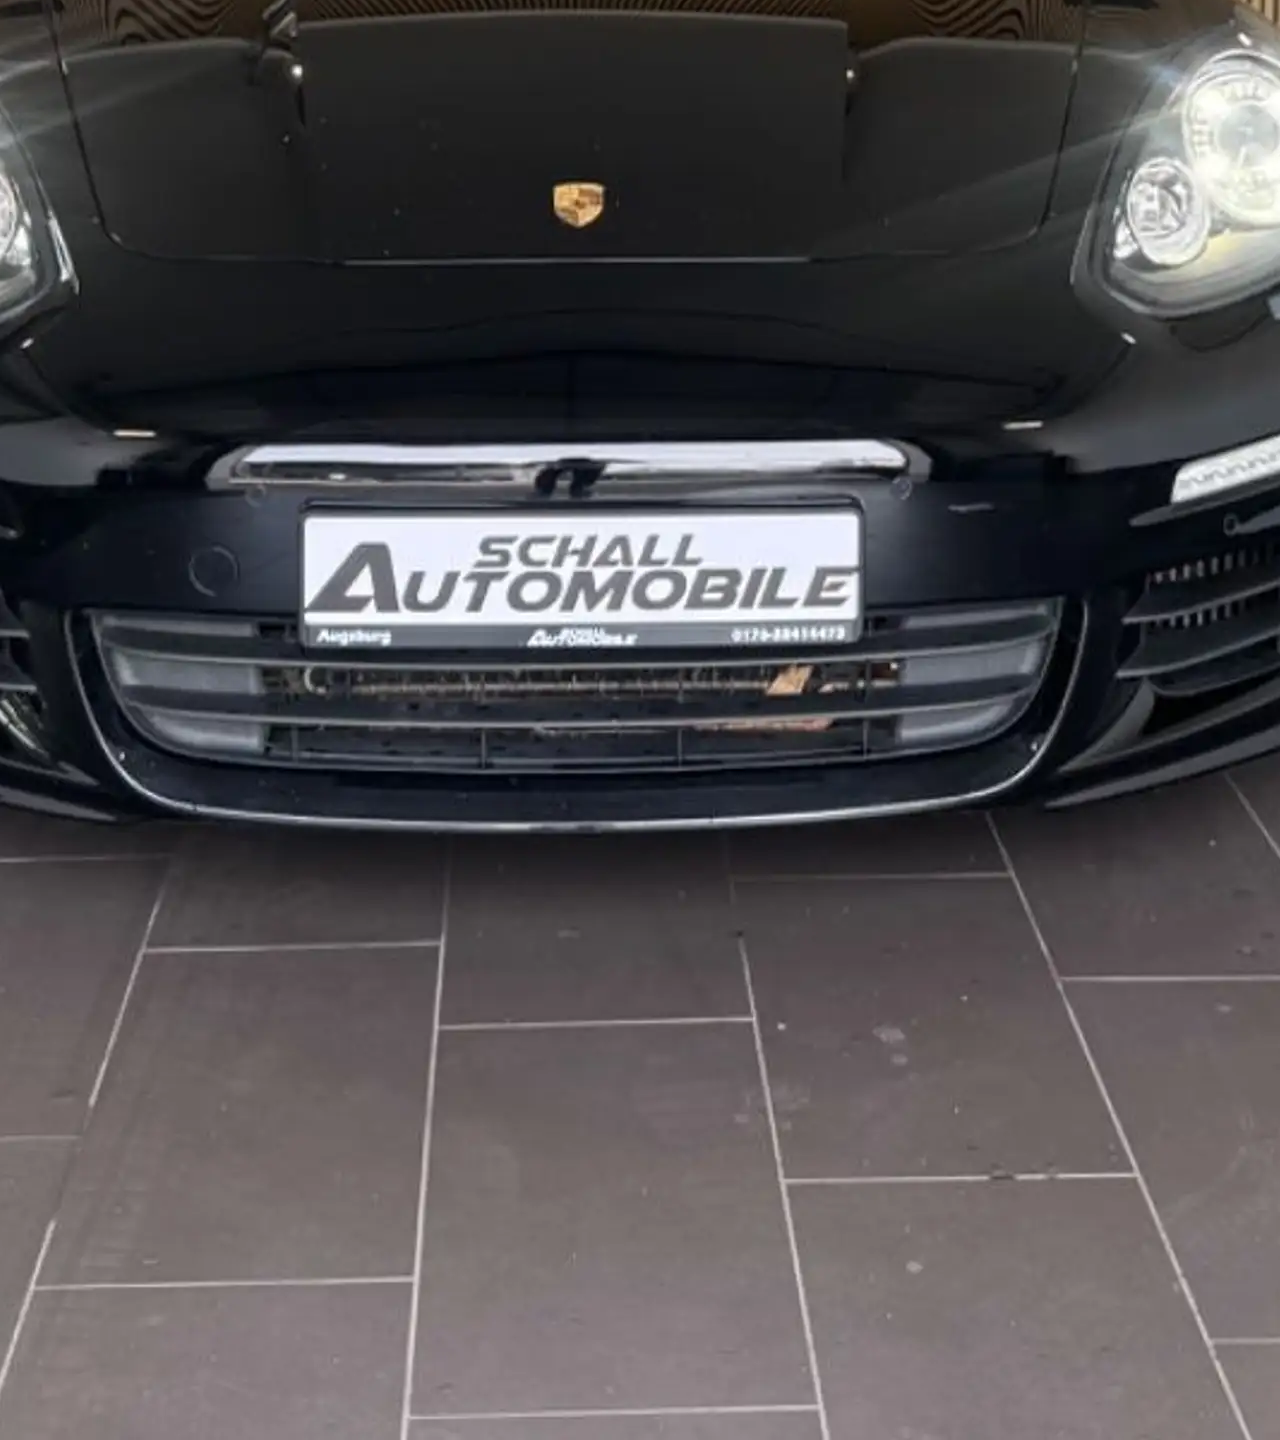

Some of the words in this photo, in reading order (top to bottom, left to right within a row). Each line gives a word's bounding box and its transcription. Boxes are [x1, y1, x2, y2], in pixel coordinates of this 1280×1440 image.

[473, 534, 702, 568] SCHALL
[305, 543, 859, 613] AUTOMOBILE
[316, 629, 392, 646] Augsburg
